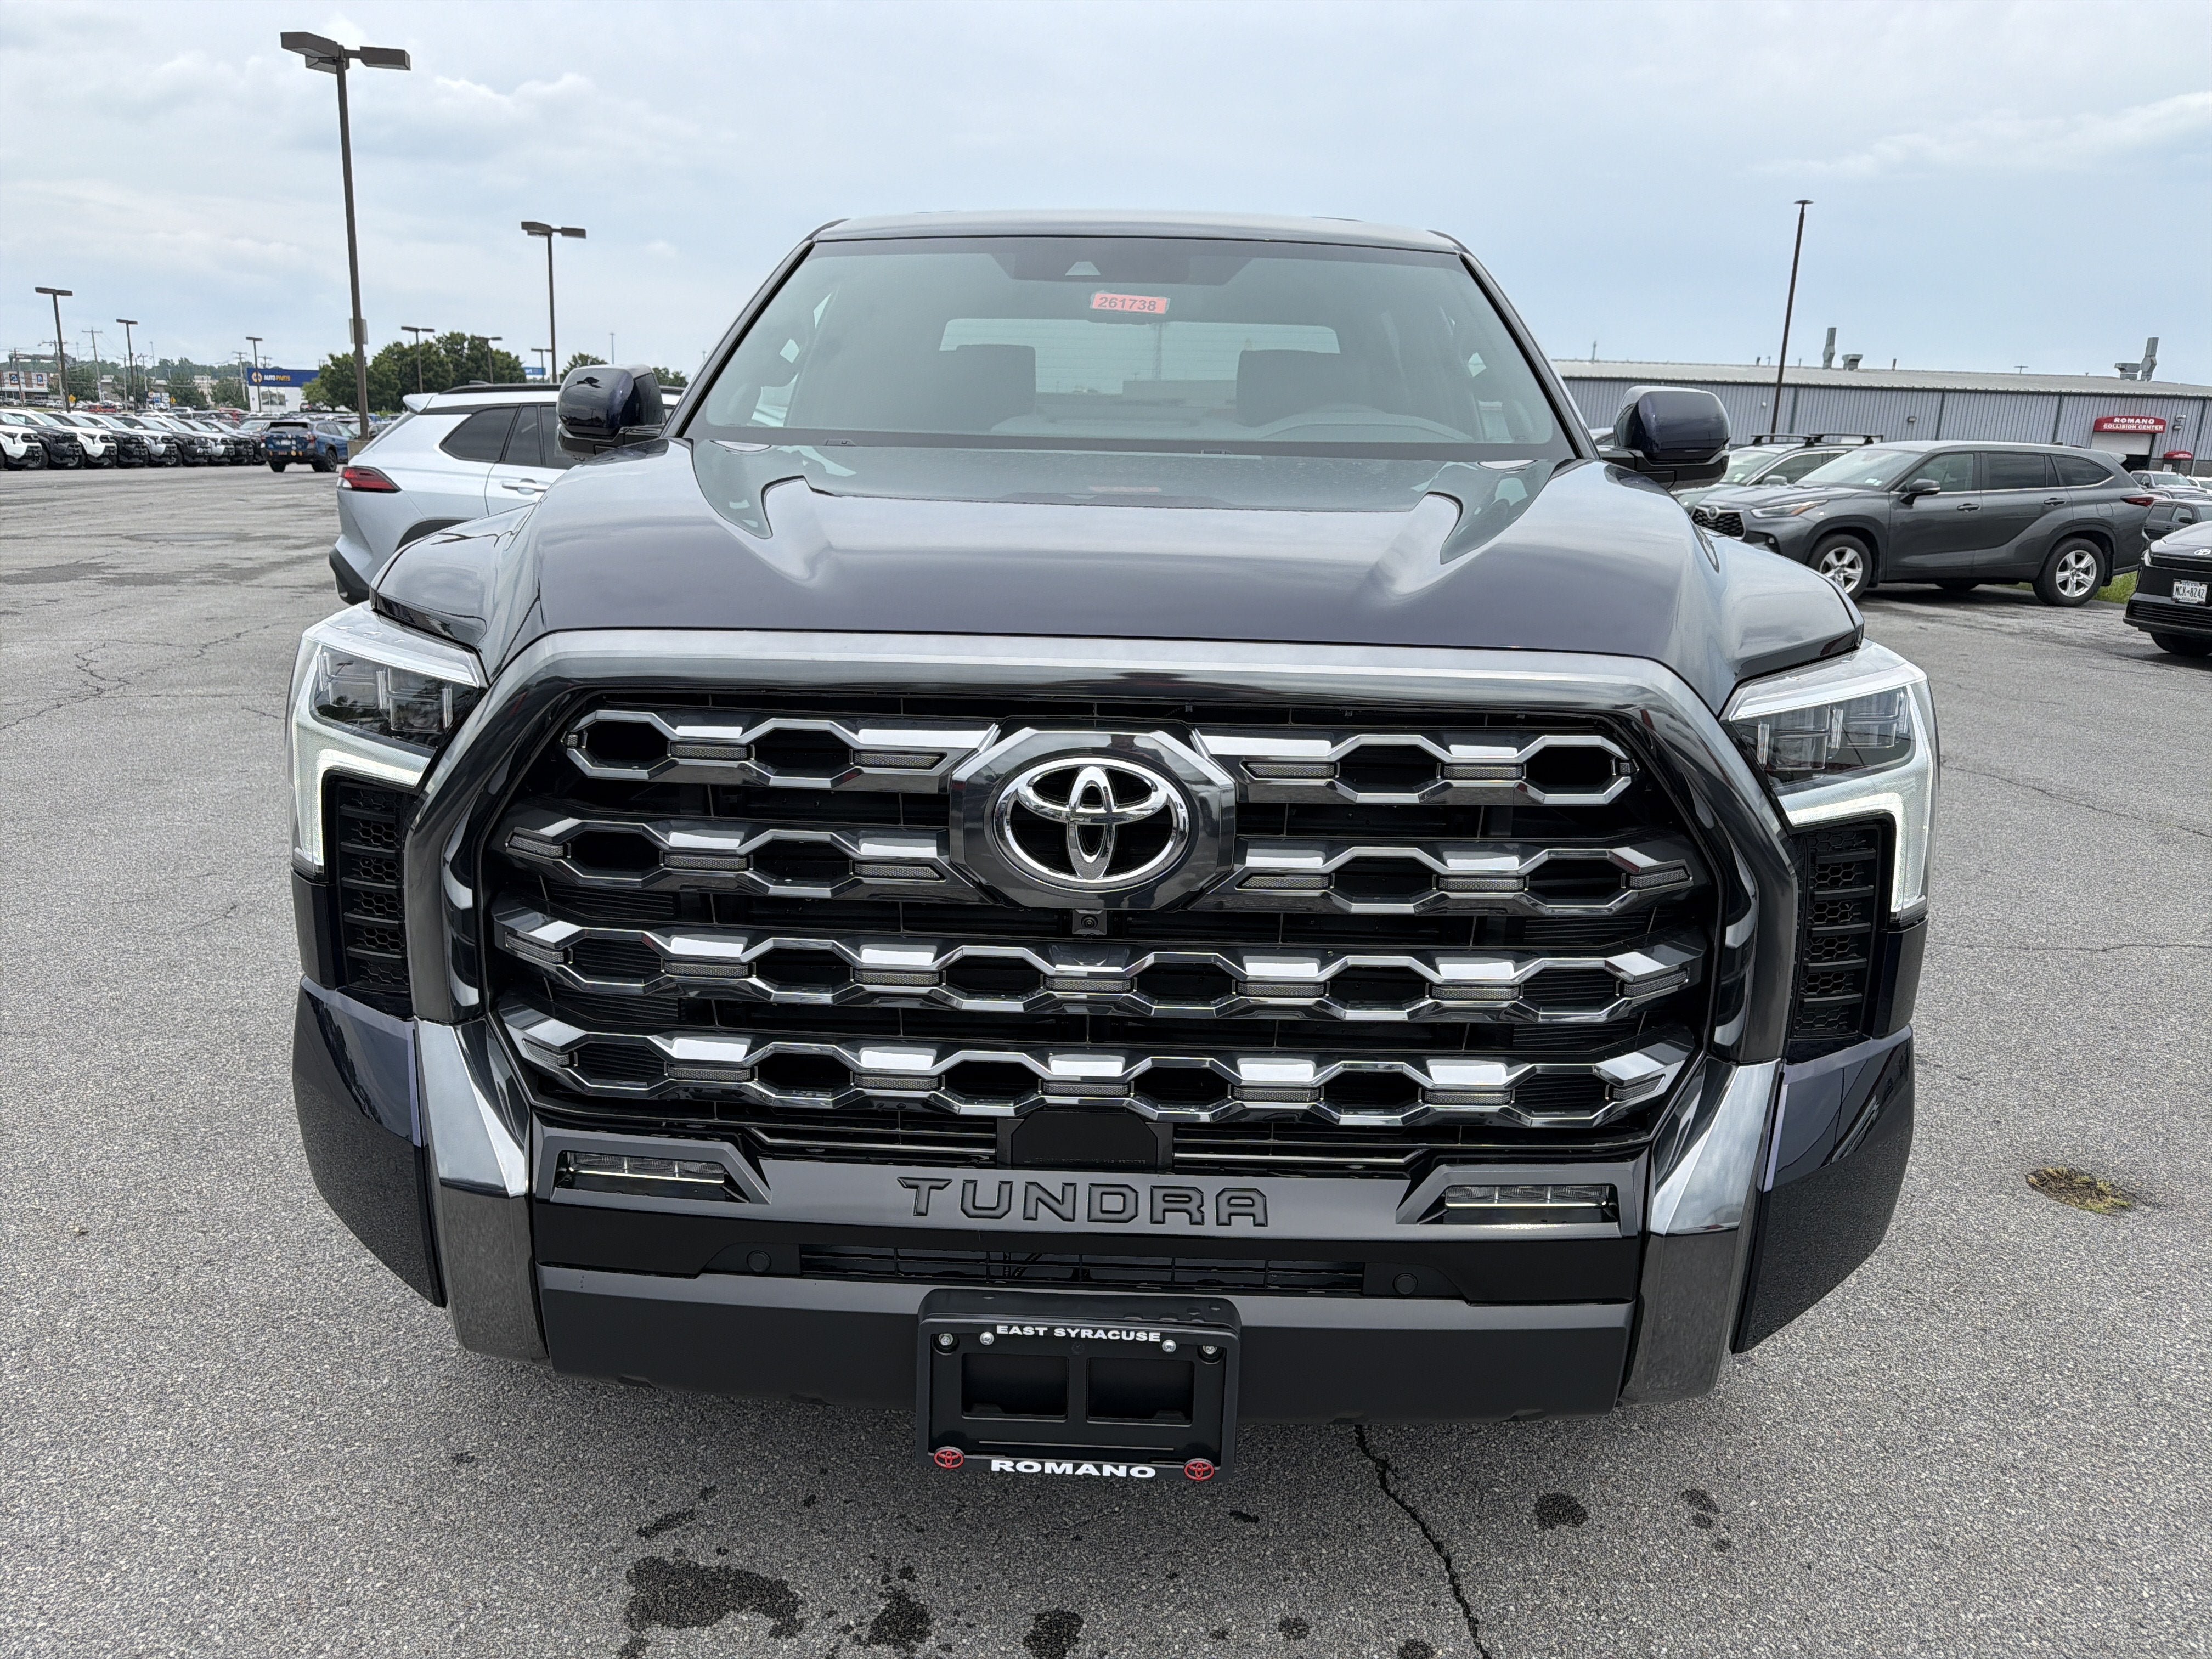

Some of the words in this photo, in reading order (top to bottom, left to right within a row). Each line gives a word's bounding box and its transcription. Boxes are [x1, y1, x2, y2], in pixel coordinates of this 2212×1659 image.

[1098, 297, 1156, 311] 261738
[897, 1176, 1268, 1227] TUNDRA
[996, 1325, 1048, 1336] EAST
[1054, 1328, 1161, 1342] SYRACUSE
[991, 1460, 1156, 1478] ROMANO
